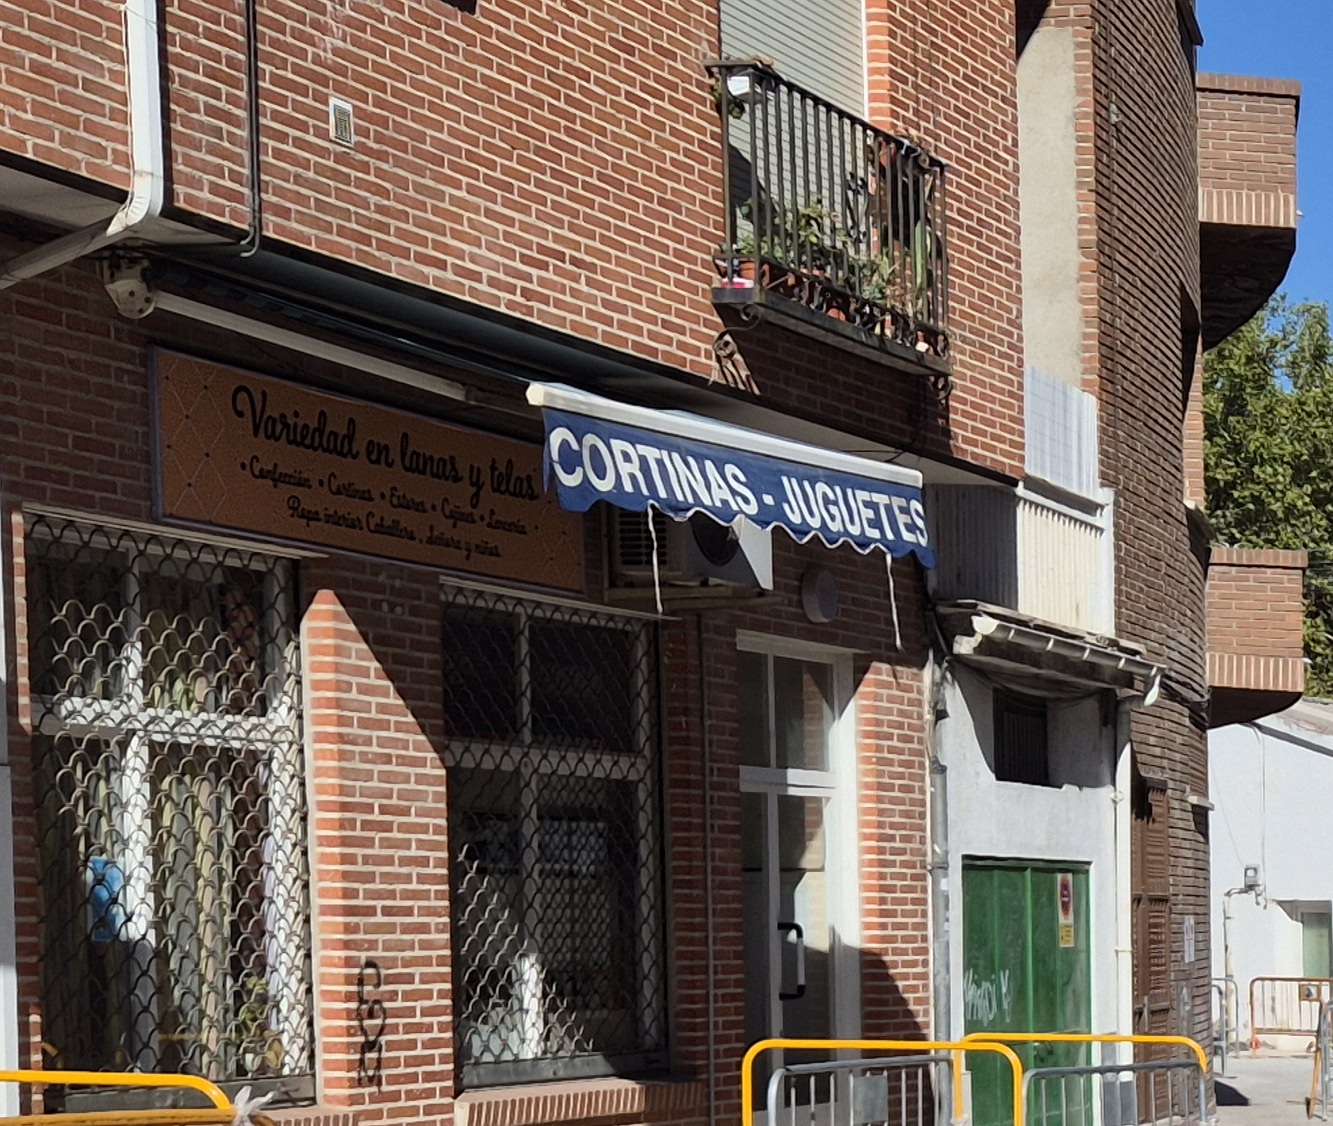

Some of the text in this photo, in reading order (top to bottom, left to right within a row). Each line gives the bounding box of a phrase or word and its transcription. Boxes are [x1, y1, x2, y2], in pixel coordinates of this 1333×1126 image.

[231, 384, 540, 510] Variedad en lanas y telas
[548, 426, 759, 516] CORTINAS
[780, 475, 928, 548] JUGUETES
